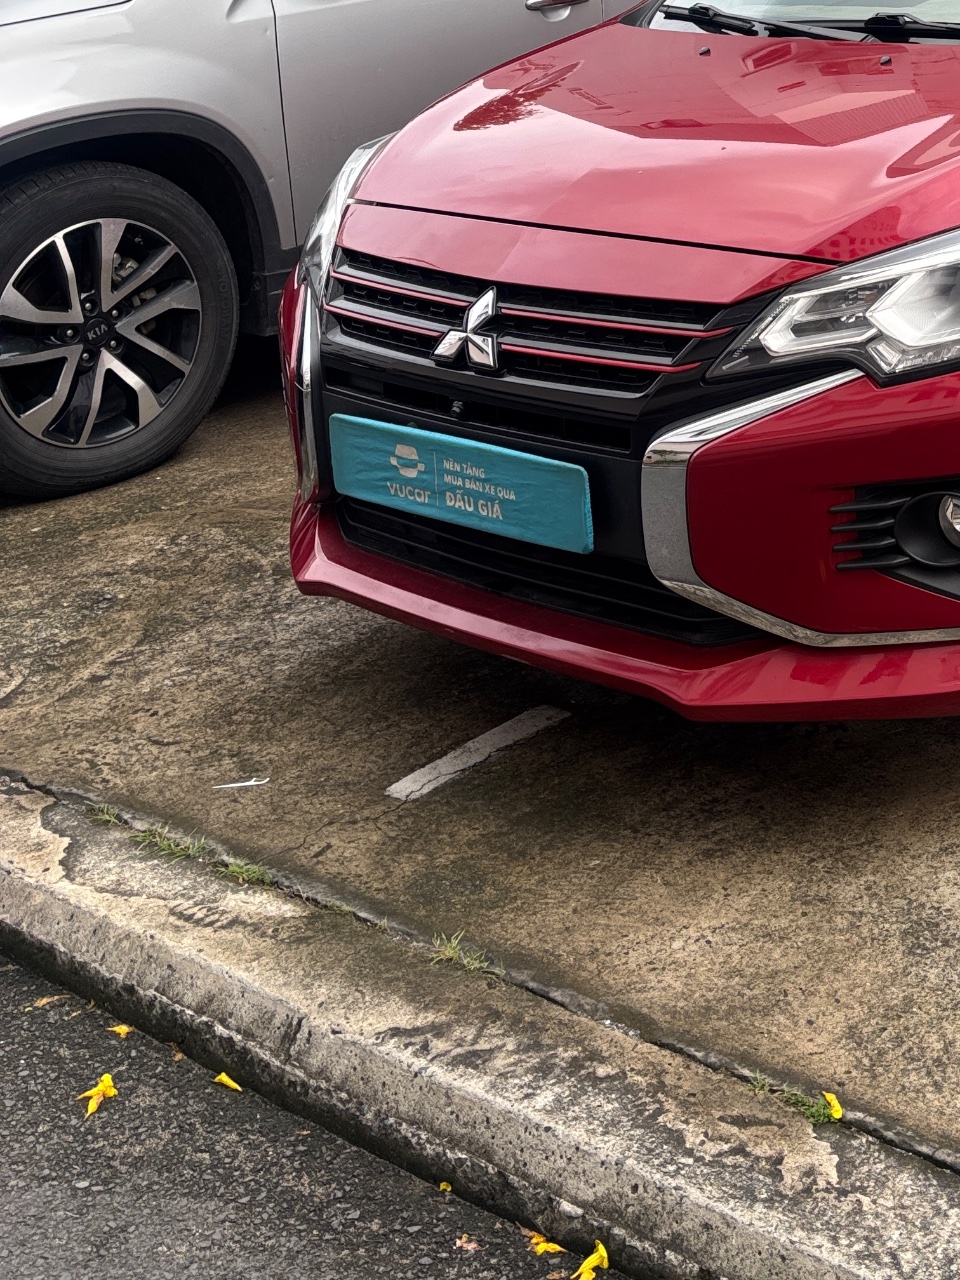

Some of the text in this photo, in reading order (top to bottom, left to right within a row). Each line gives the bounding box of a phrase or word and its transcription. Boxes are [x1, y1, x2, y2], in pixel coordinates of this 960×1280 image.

[87, 324, 108, 340] KIA
[443, 457, 485, 478] NỀN TẢNG
[386, 481, 431, 504] vucar
[443, 474, 516, 501] MUA BÁN XE QUA
[445, 488, 503, 520] ĐẤU GIÁ
